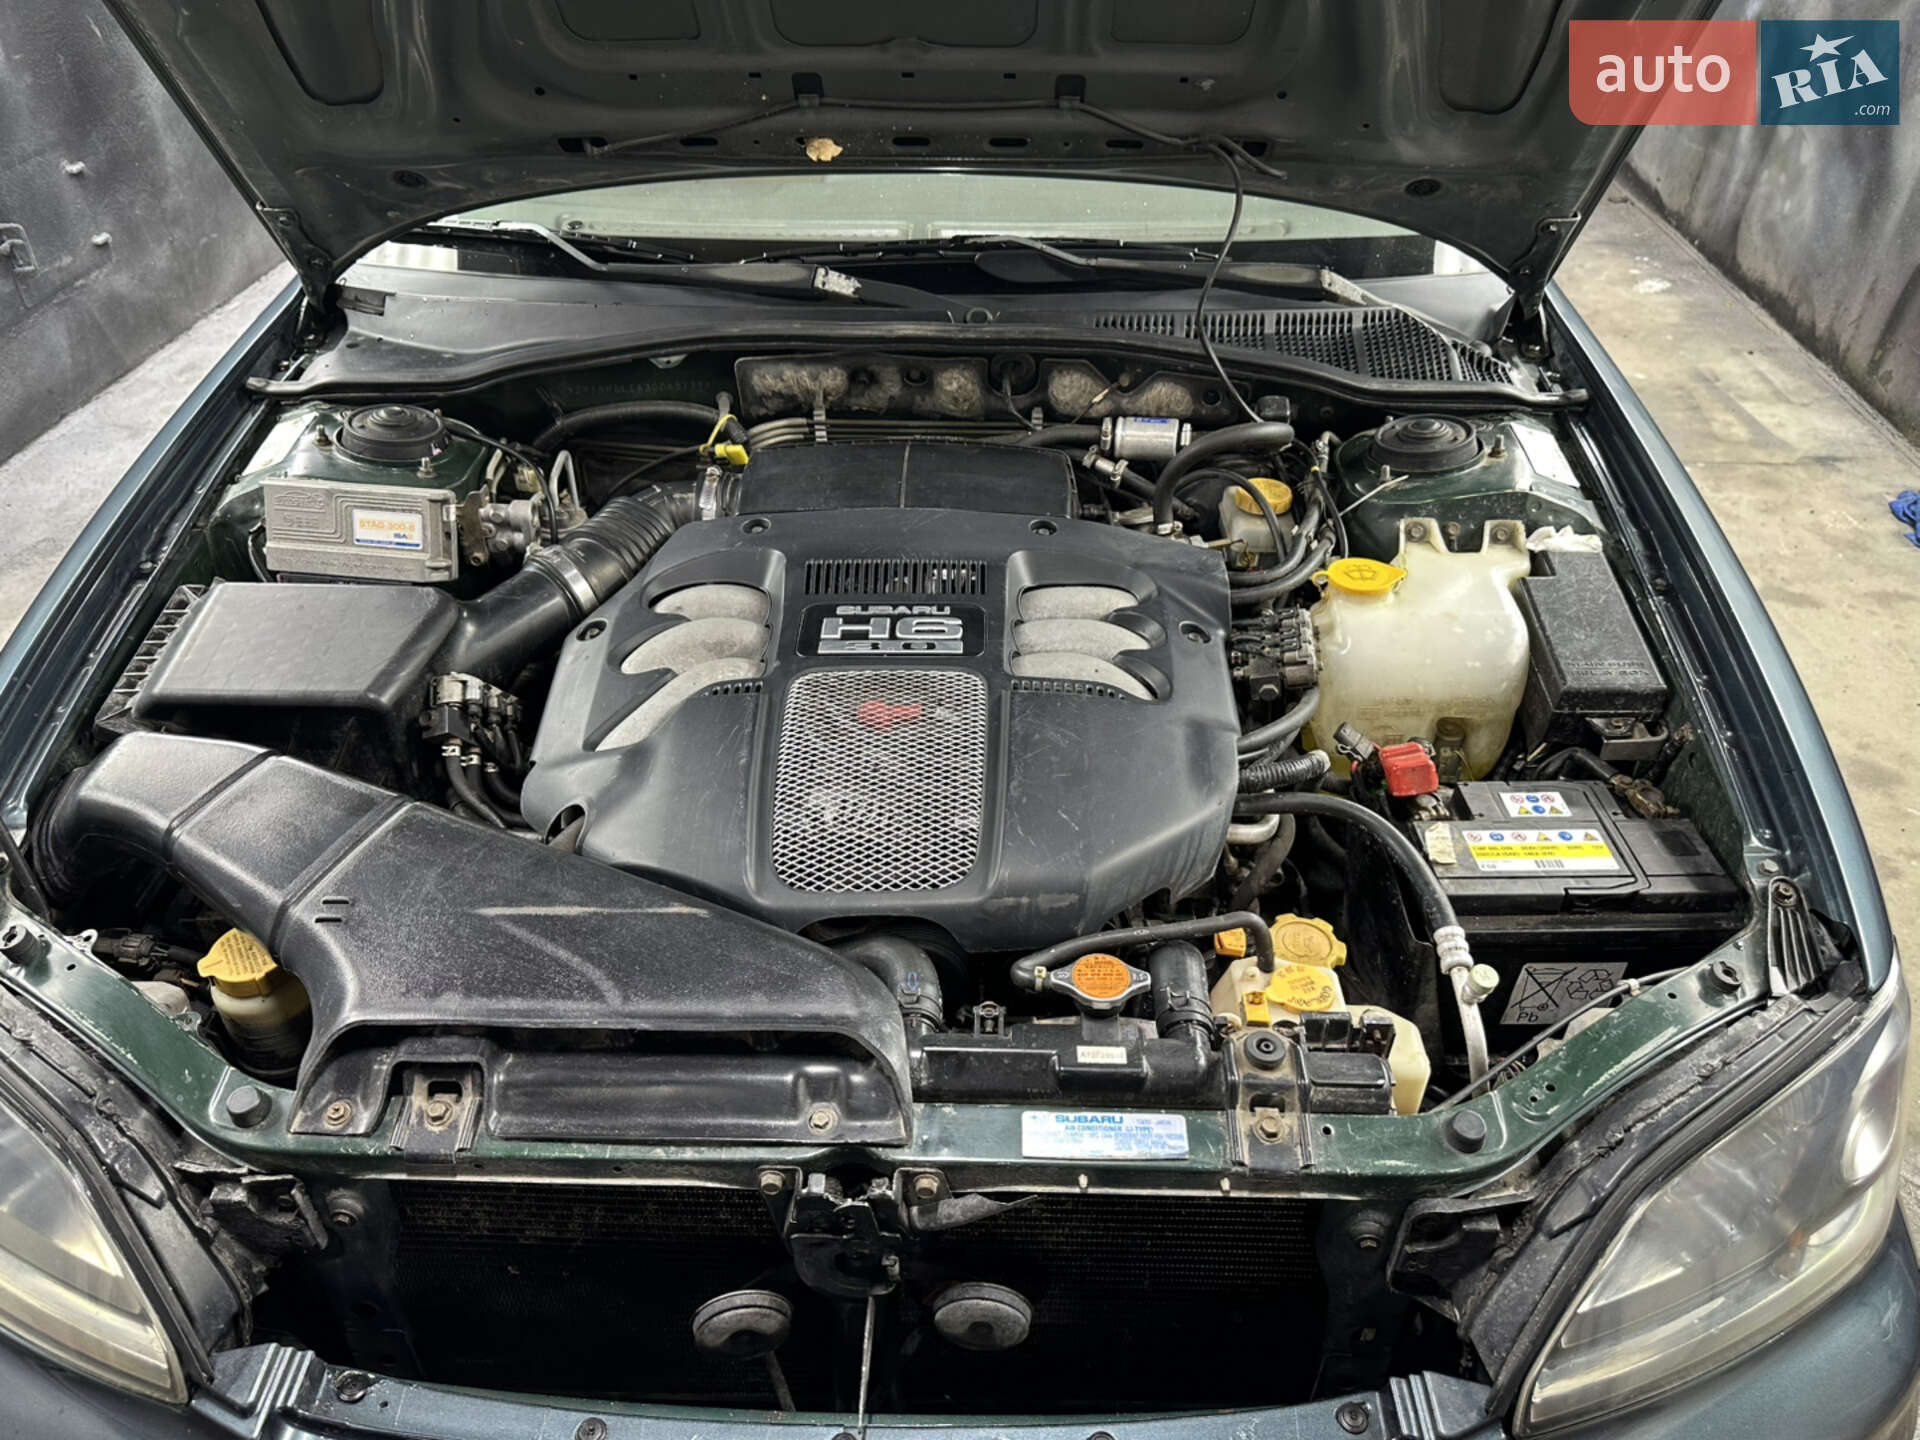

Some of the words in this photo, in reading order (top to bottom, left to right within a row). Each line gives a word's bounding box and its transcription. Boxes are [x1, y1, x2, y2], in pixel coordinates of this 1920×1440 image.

[836, 605, 951, 615] SUBARU
[820, 617, 964, 639] H6
[1517, 1011, 1539, 1022] Pb
[1055, 1114, 1124, 1124] SUBARU
